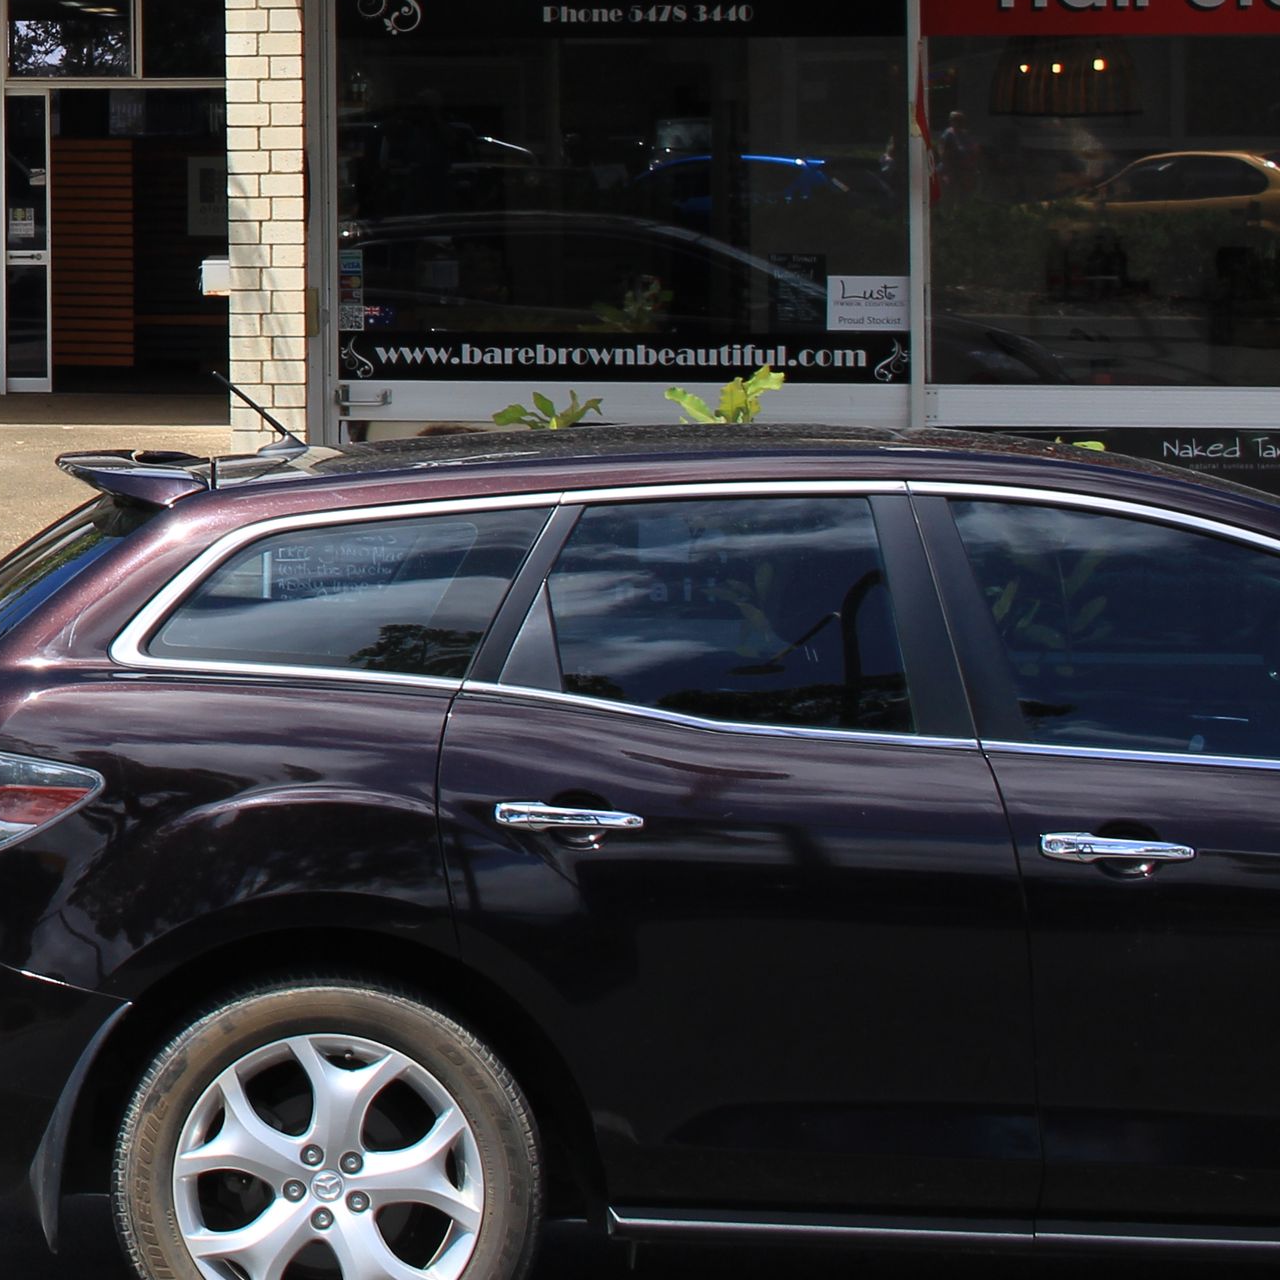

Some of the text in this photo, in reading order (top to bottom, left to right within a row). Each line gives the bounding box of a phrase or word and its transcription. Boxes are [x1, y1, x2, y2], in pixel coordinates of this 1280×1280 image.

[543, 4, 753, 22] Phone 5478 3440
[838, 316, 901, 325] Proud Stockist
[374, 342, 867, 369] www.barebrownbeautiful.com
[1163, 436, 1280, 458] Naked Ta
